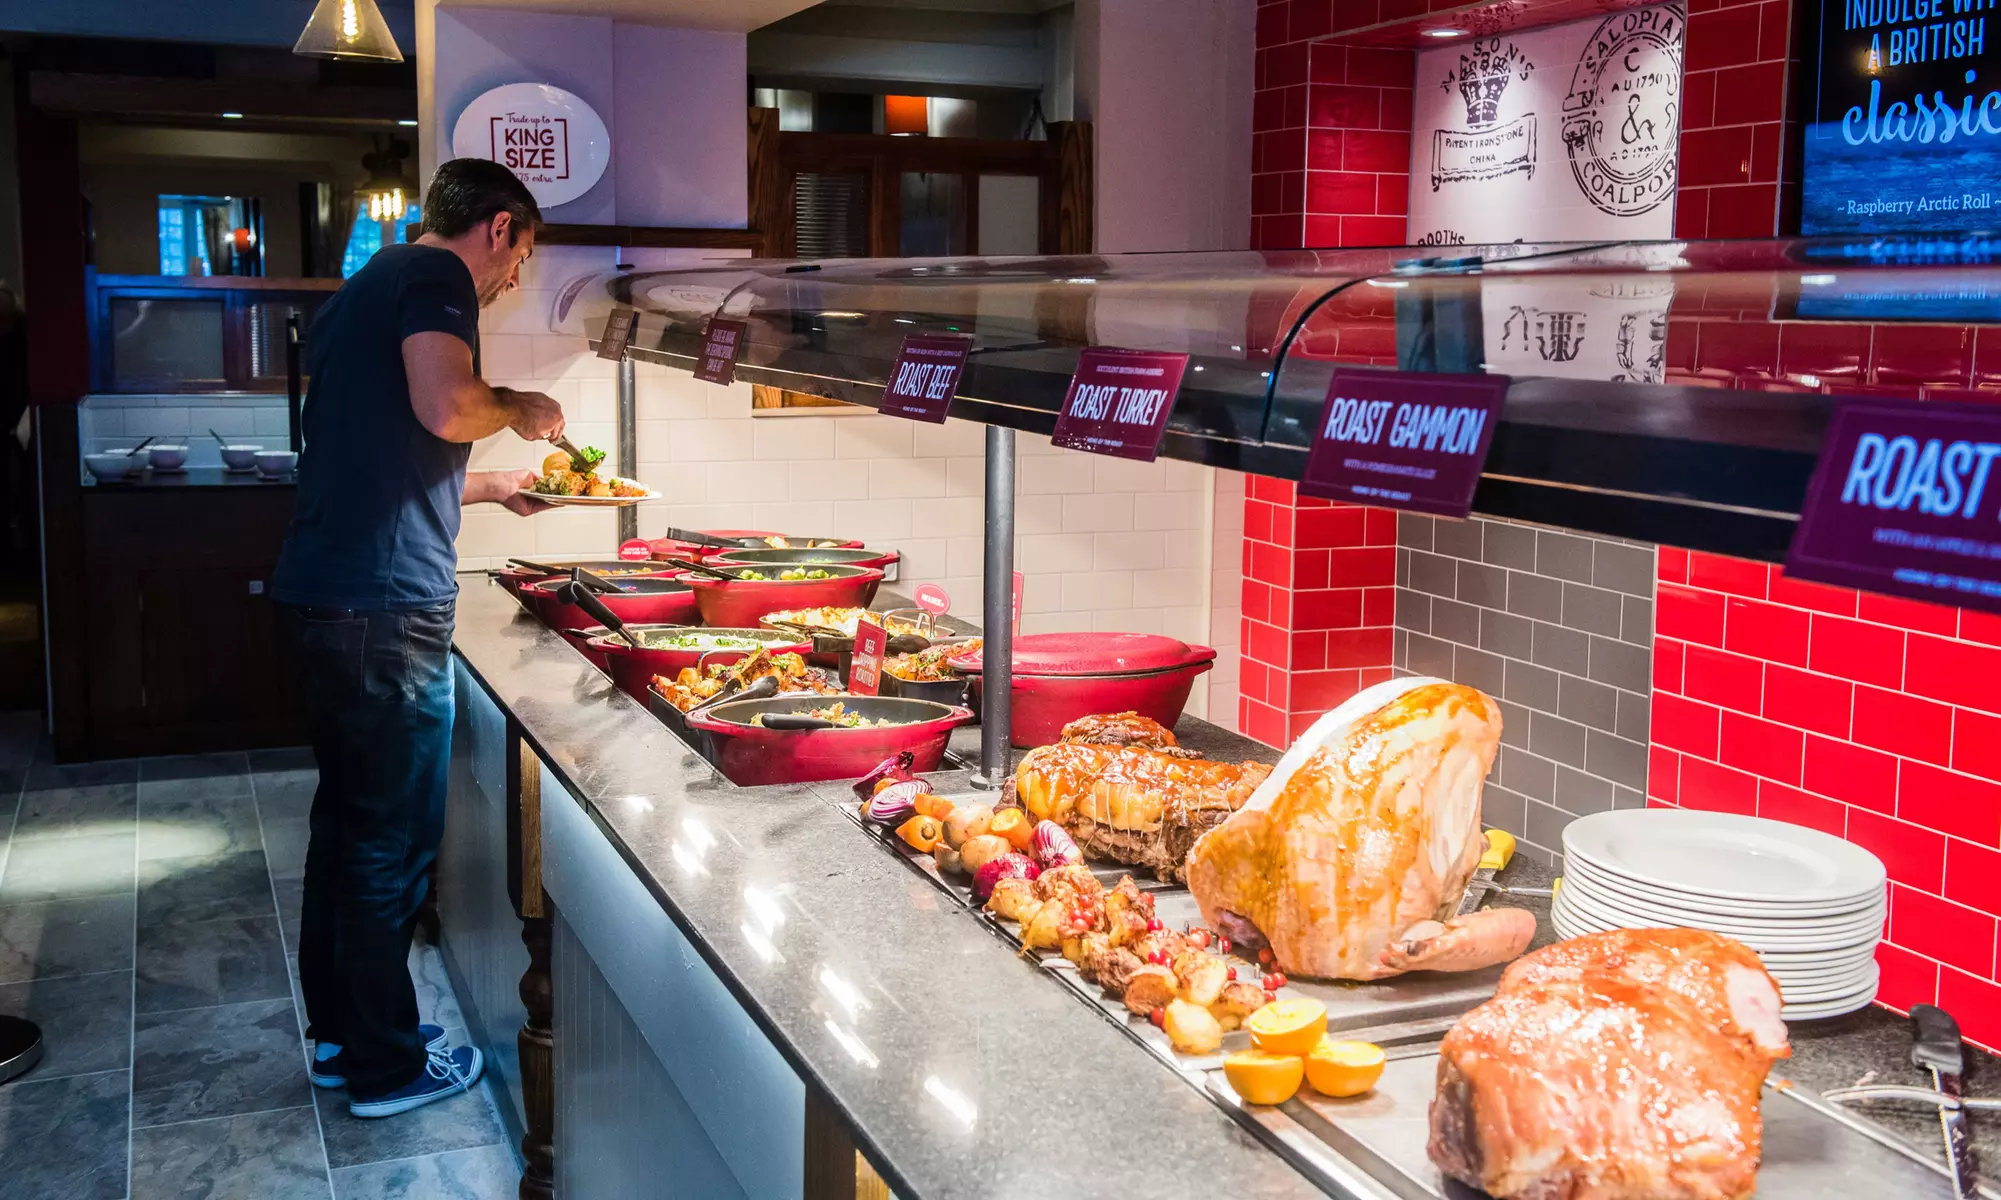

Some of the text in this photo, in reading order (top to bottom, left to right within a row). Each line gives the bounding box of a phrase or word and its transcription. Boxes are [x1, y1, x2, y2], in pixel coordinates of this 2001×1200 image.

[1868, 18, 1985, 68] A BRITISH
[1842, 69, 2001, 145] classic
[505, 112, 551, 128] Trade up to
[504, 128, 554, 146] KING
[505, 148, 555, 169] SIZE
[1470, 153, 1496, 164] CHINA
[532, 174, 553, 183] extra
[1847, 193, 1991, 217] Raspberry Arctic Roll
[893, 361, 956, 399] ROAST BEEF
[1069, 383, 1169, 426] ROAST TURKEY
[1324, 397, 1487, 455] ROAST GAMMON
[1840, 432, 2001, 520] ROAST
[865, 638, 875, 654] BEEF
